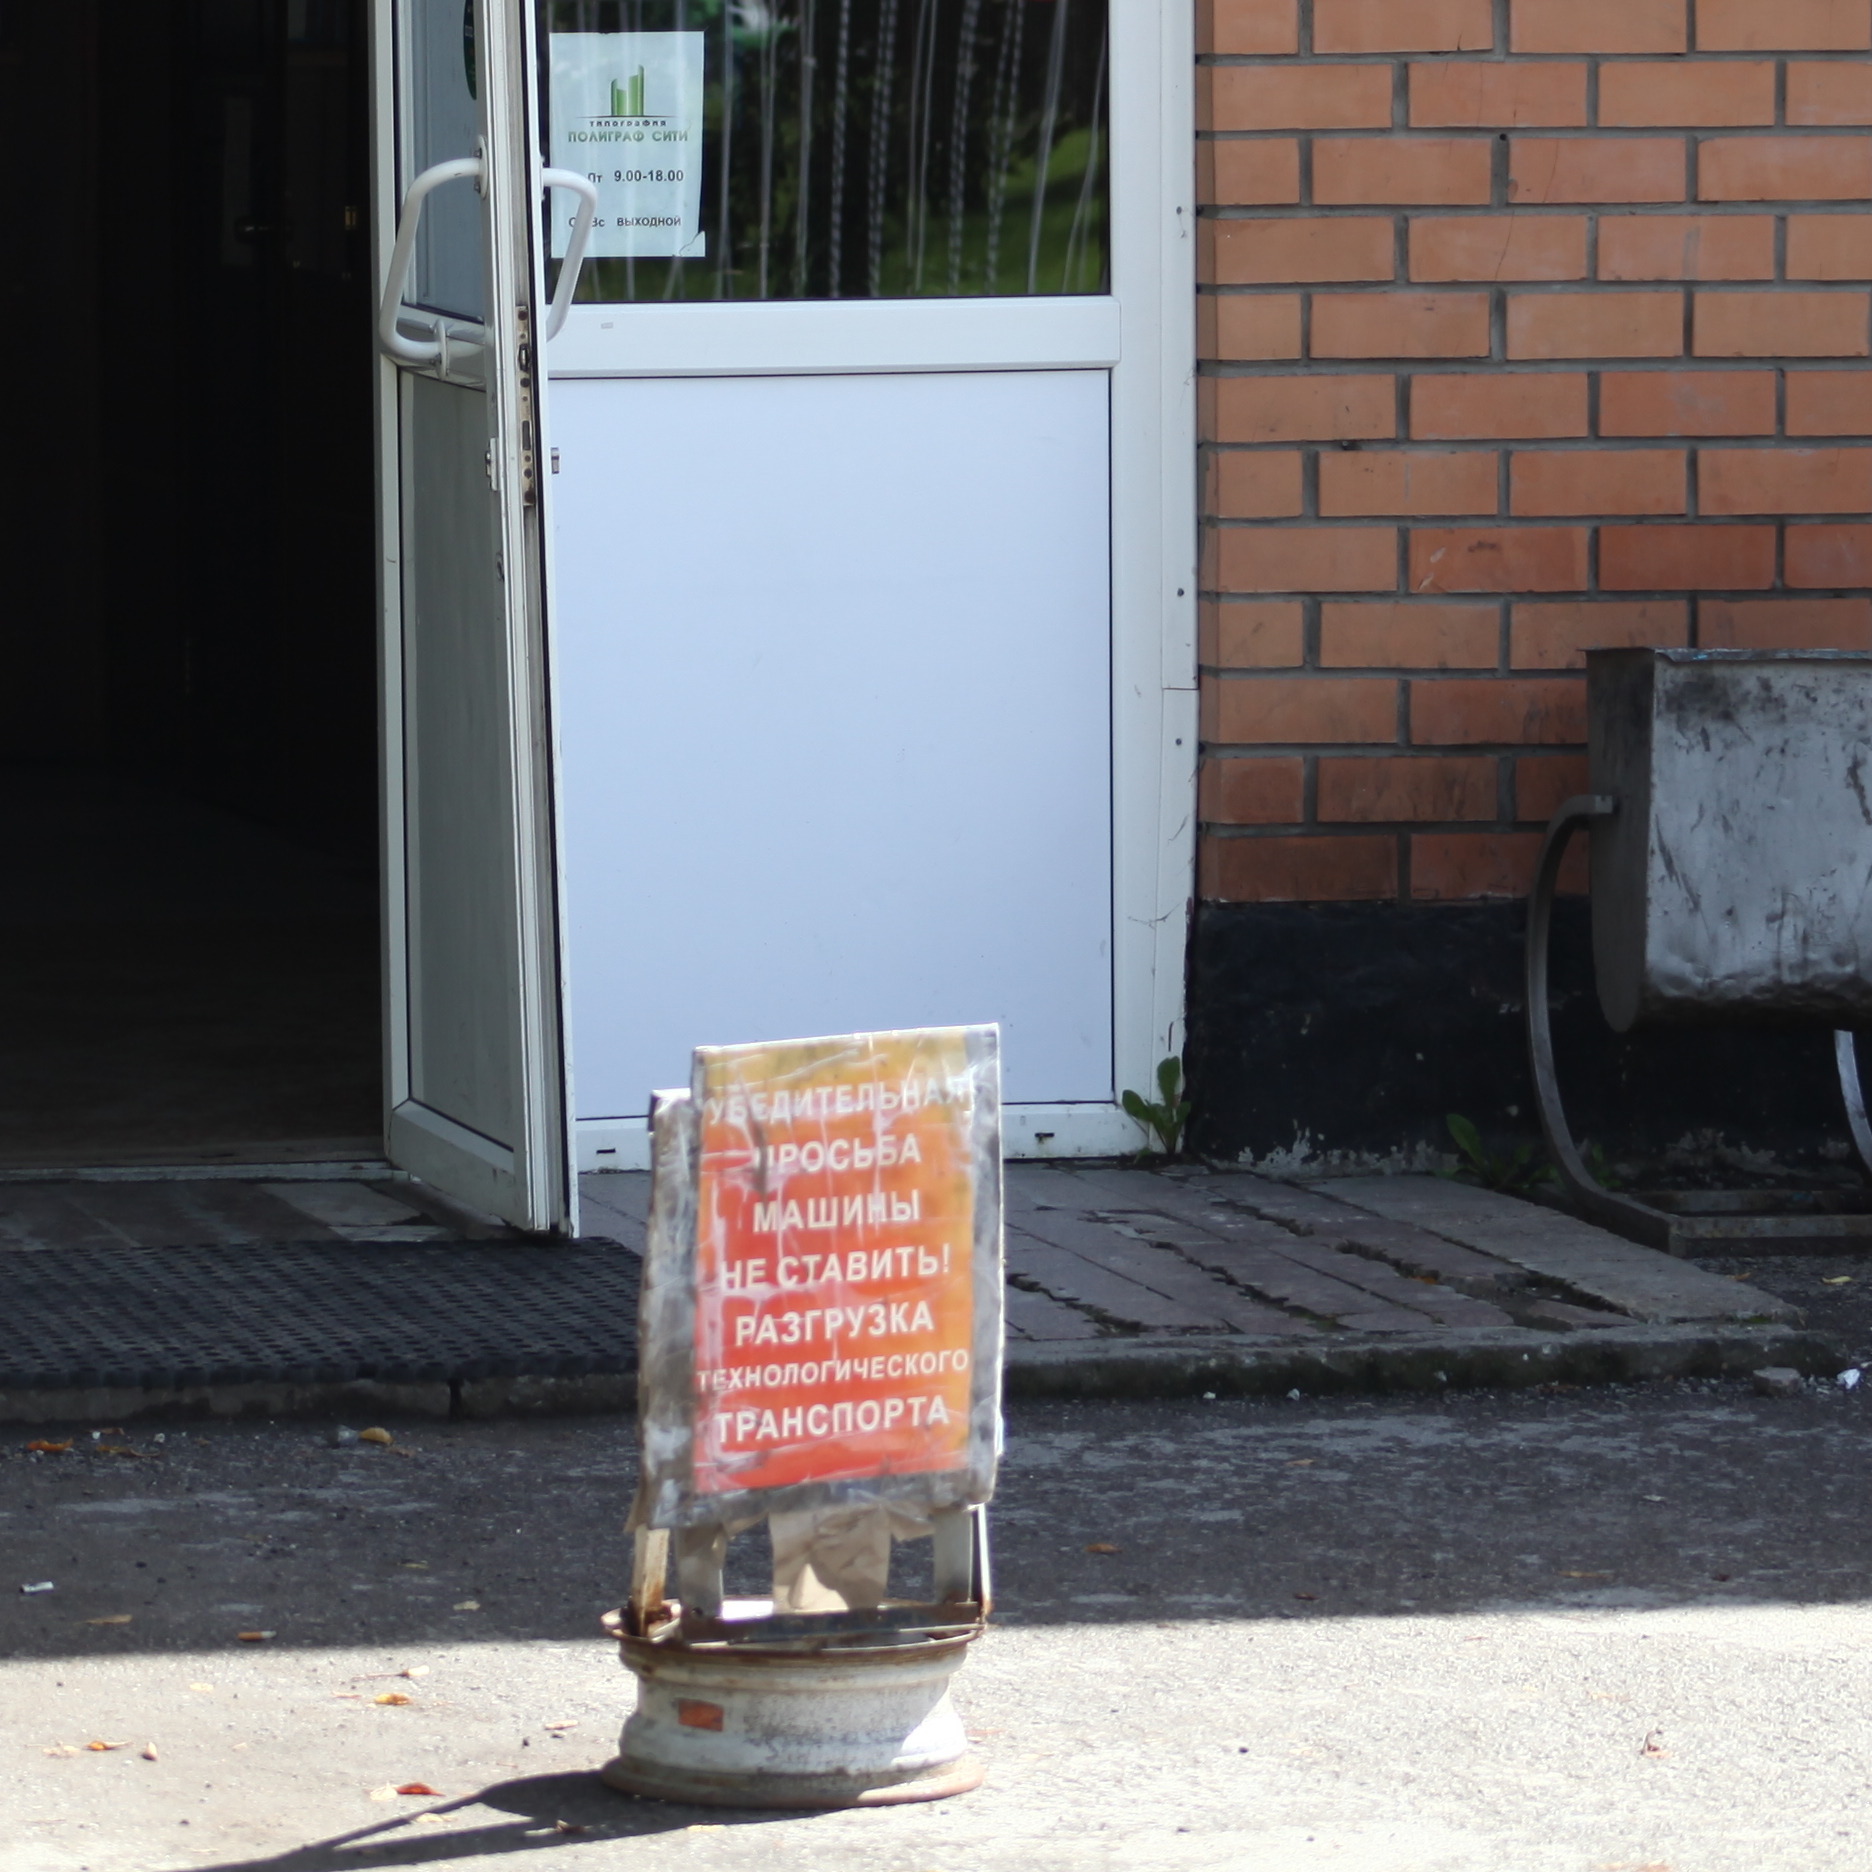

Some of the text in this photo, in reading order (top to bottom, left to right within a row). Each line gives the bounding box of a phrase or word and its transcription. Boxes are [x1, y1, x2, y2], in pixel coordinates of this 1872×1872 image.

[567, 129, 689, 143] ПОЛИГРАФ СИТИ
[589, 119, 667, 128] типография
[614, 169, 684, 183] 9.00-18.00
[752, 1188, 920, 1234] МАШИНЫ
[723, 1243, 950, 1291] НЕ СТАВИТЬ!
[735, 1301, 934, 1347] РАЗГРУЗКА
[697, 1348, 969, 1394] ТЕХНОЛОГИЧЕСКОГО
[716, 1395, 950, 1443] ТРАНСПОРТА
